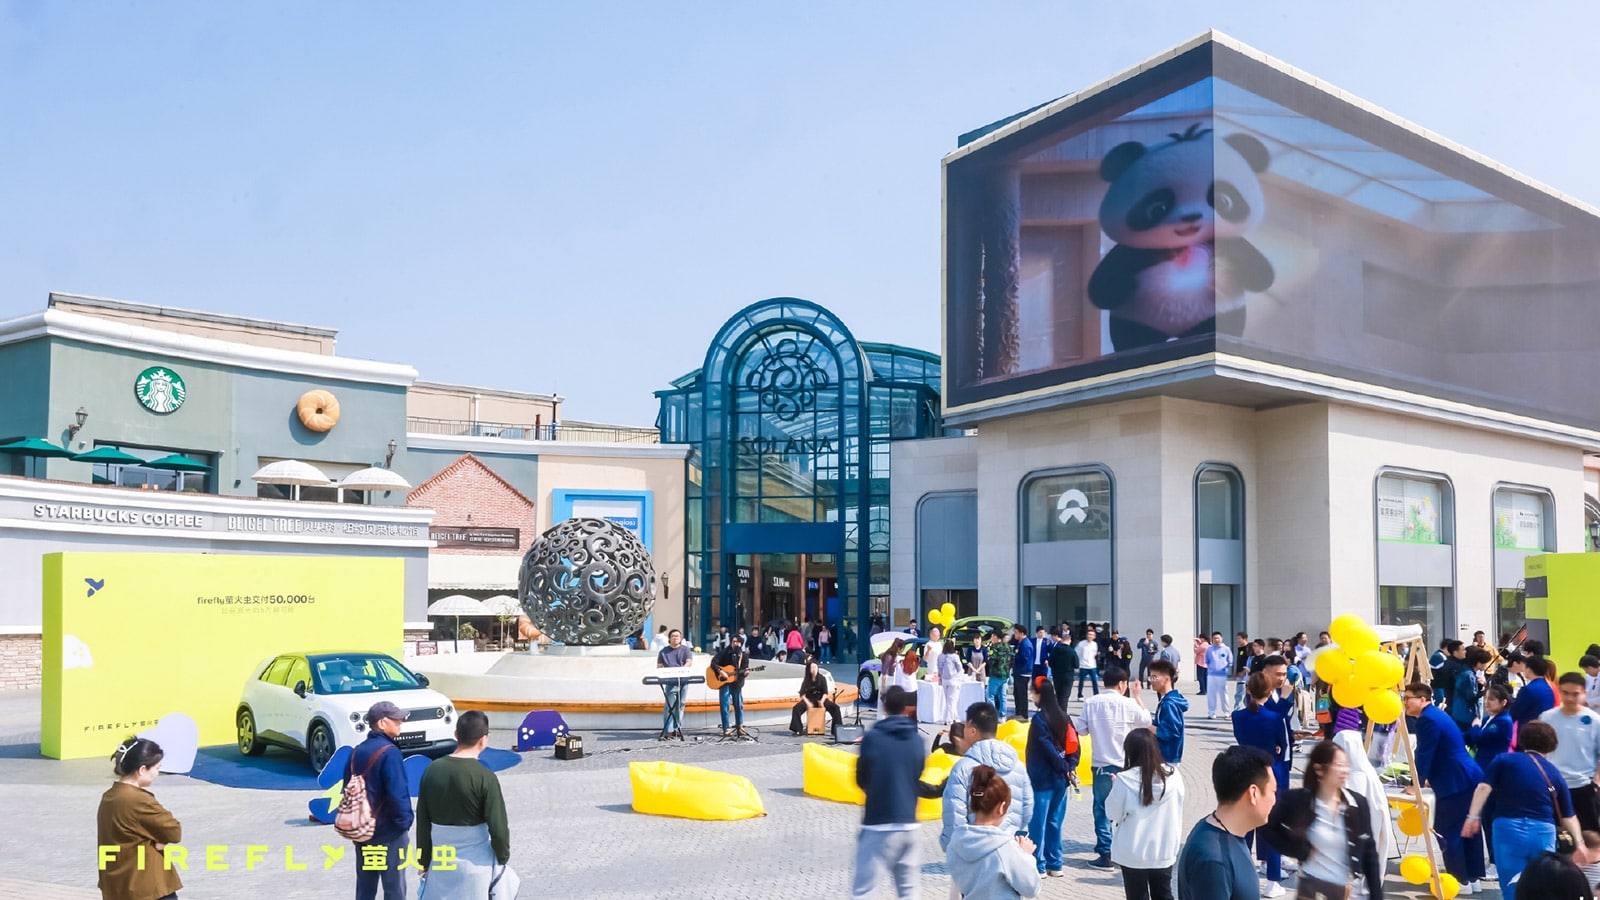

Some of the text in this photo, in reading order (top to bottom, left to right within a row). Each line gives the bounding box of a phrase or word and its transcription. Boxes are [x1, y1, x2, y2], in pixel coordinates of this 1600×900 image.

[740, 436, 835, 454] SOLANA
[34, 504, 204, 528] STARBUCKS COFFEE
[272, 518, 302, 534] TREE
[83, 721, 137, 733] FIREFLY
